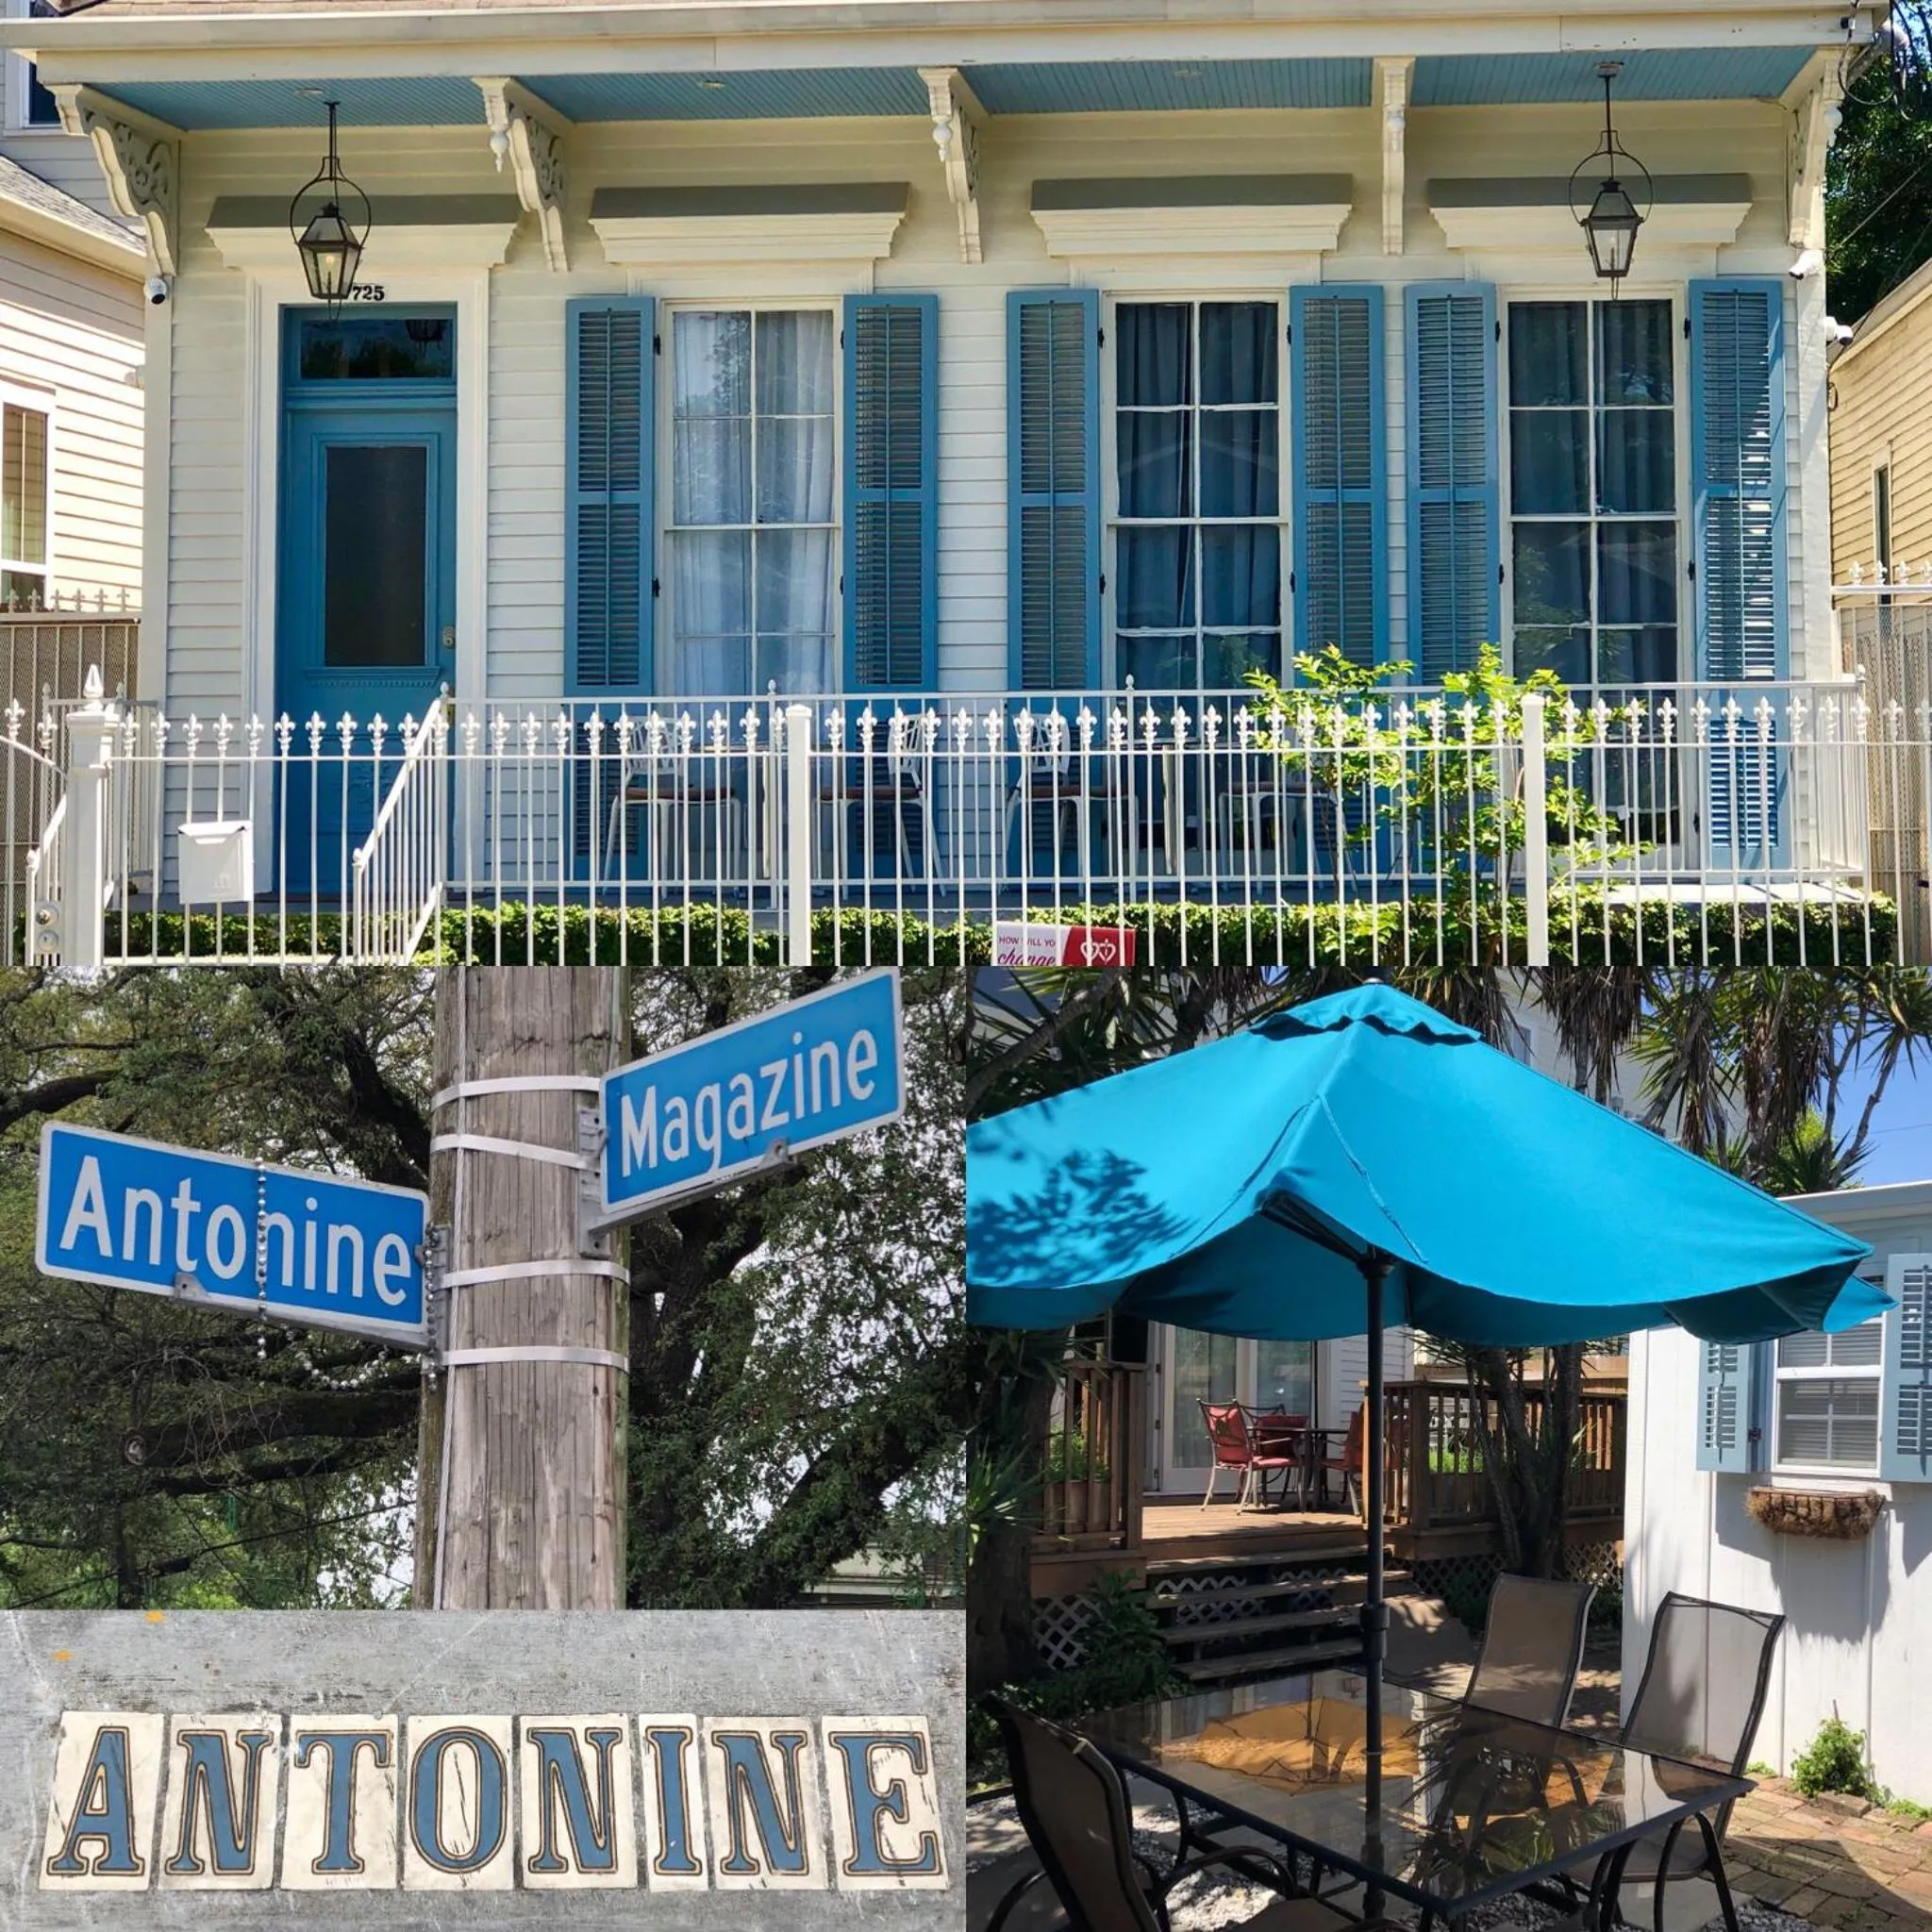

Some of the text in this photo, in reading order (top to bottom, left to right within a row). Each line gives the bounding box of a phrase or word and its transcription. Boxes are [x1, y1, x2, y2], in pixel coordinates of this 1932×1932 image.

[352, 285, 385, 302] 725
[999, 936, 1020, 944] HOW
[1044, 939, 1059, 948] YO
[621, 1029, 878, 1178] Magazine
[58, 1155, 412, 1307] Antonine
[46, 1726, 941, 1875] ANTONINE
